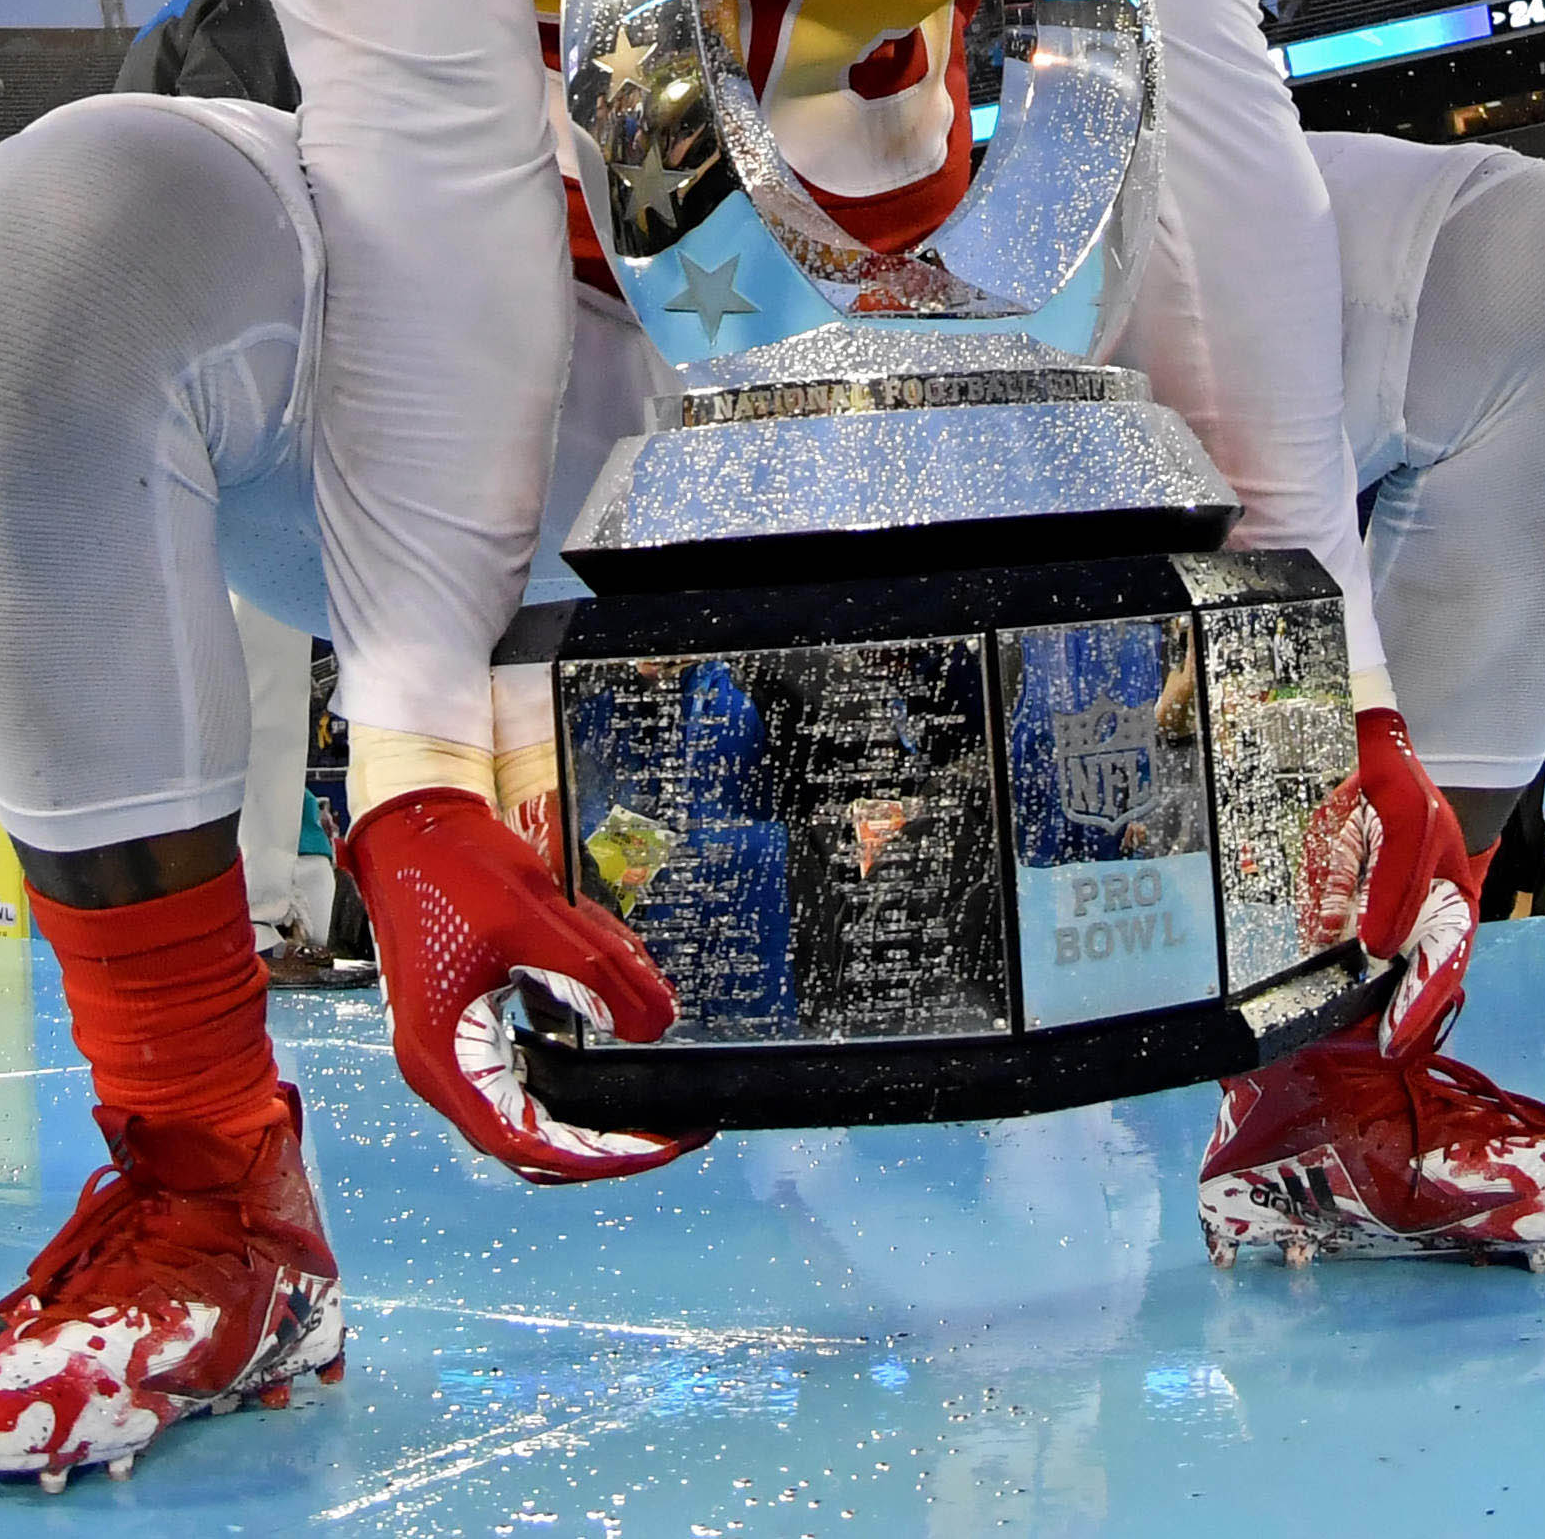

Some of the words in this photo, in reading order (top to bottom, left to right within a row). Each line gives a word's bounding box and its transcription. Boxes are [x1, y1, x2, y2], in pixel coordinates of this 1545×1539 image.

[712, 380, 871, 421] NATIONAL
[882, 370, 1038, 407] FOOTBALL
[1065, 746, 1152, 818] NFL
[1071, 866, 1163, 918] PRO
[1055, 911, 1187, 967] BOWL
